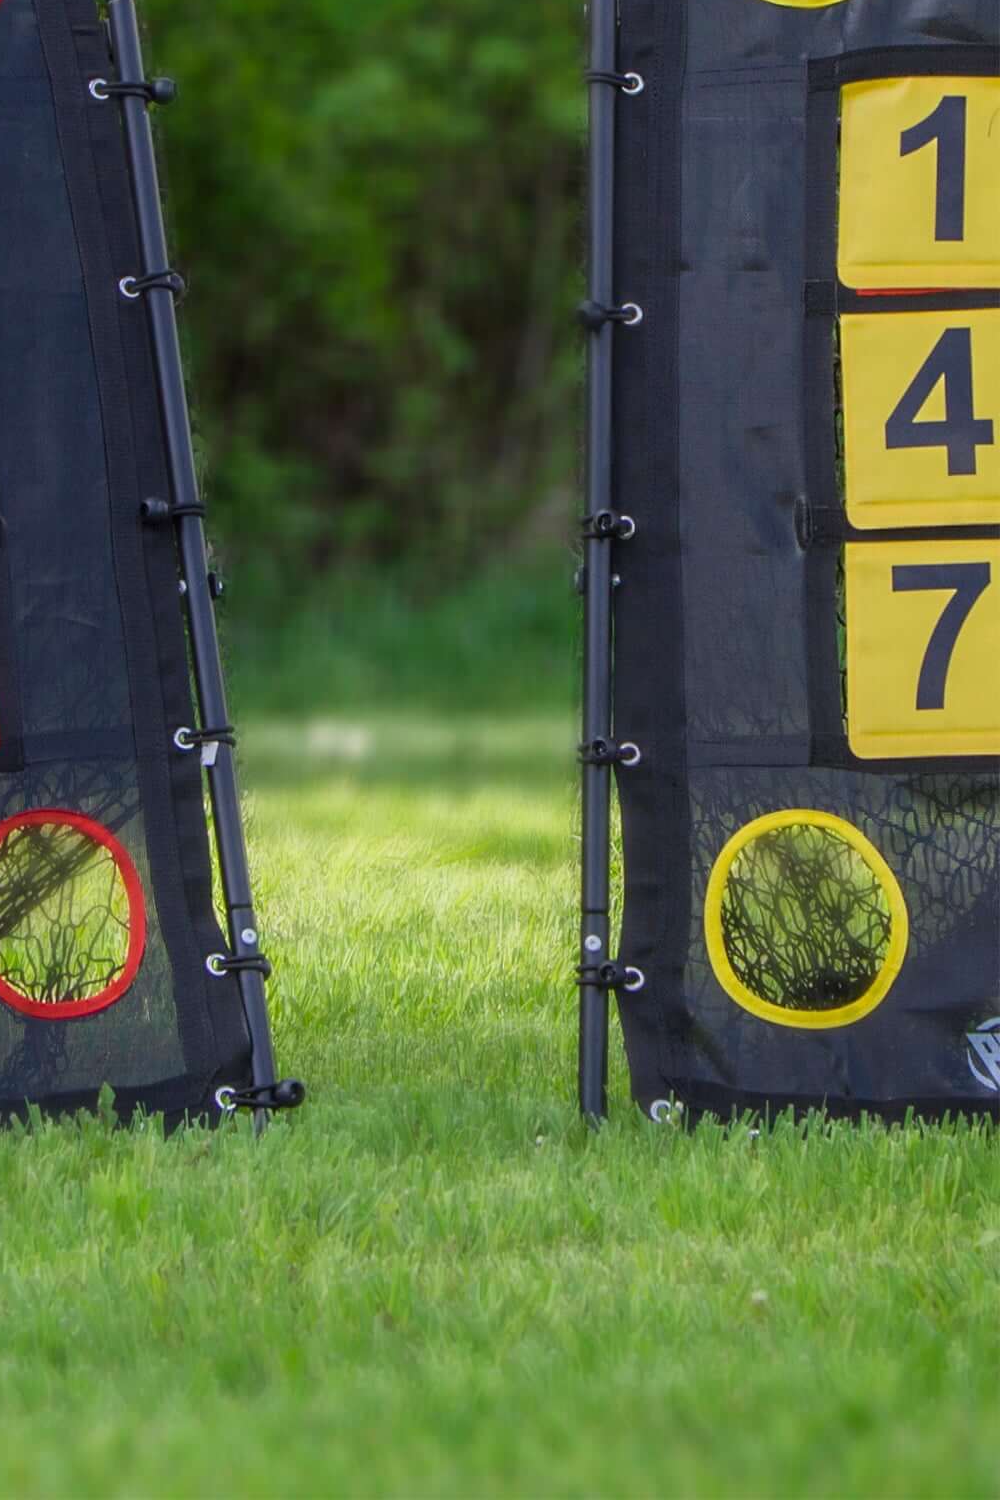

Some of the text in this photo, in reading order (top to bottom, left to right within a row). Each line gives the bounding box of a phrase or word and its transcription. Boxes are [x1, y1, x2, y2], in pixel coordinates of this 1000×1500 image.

[899, 94, 968, 243] 1
[884, 326, 995, 477] 4
[891, 560, 992, 711] 7
